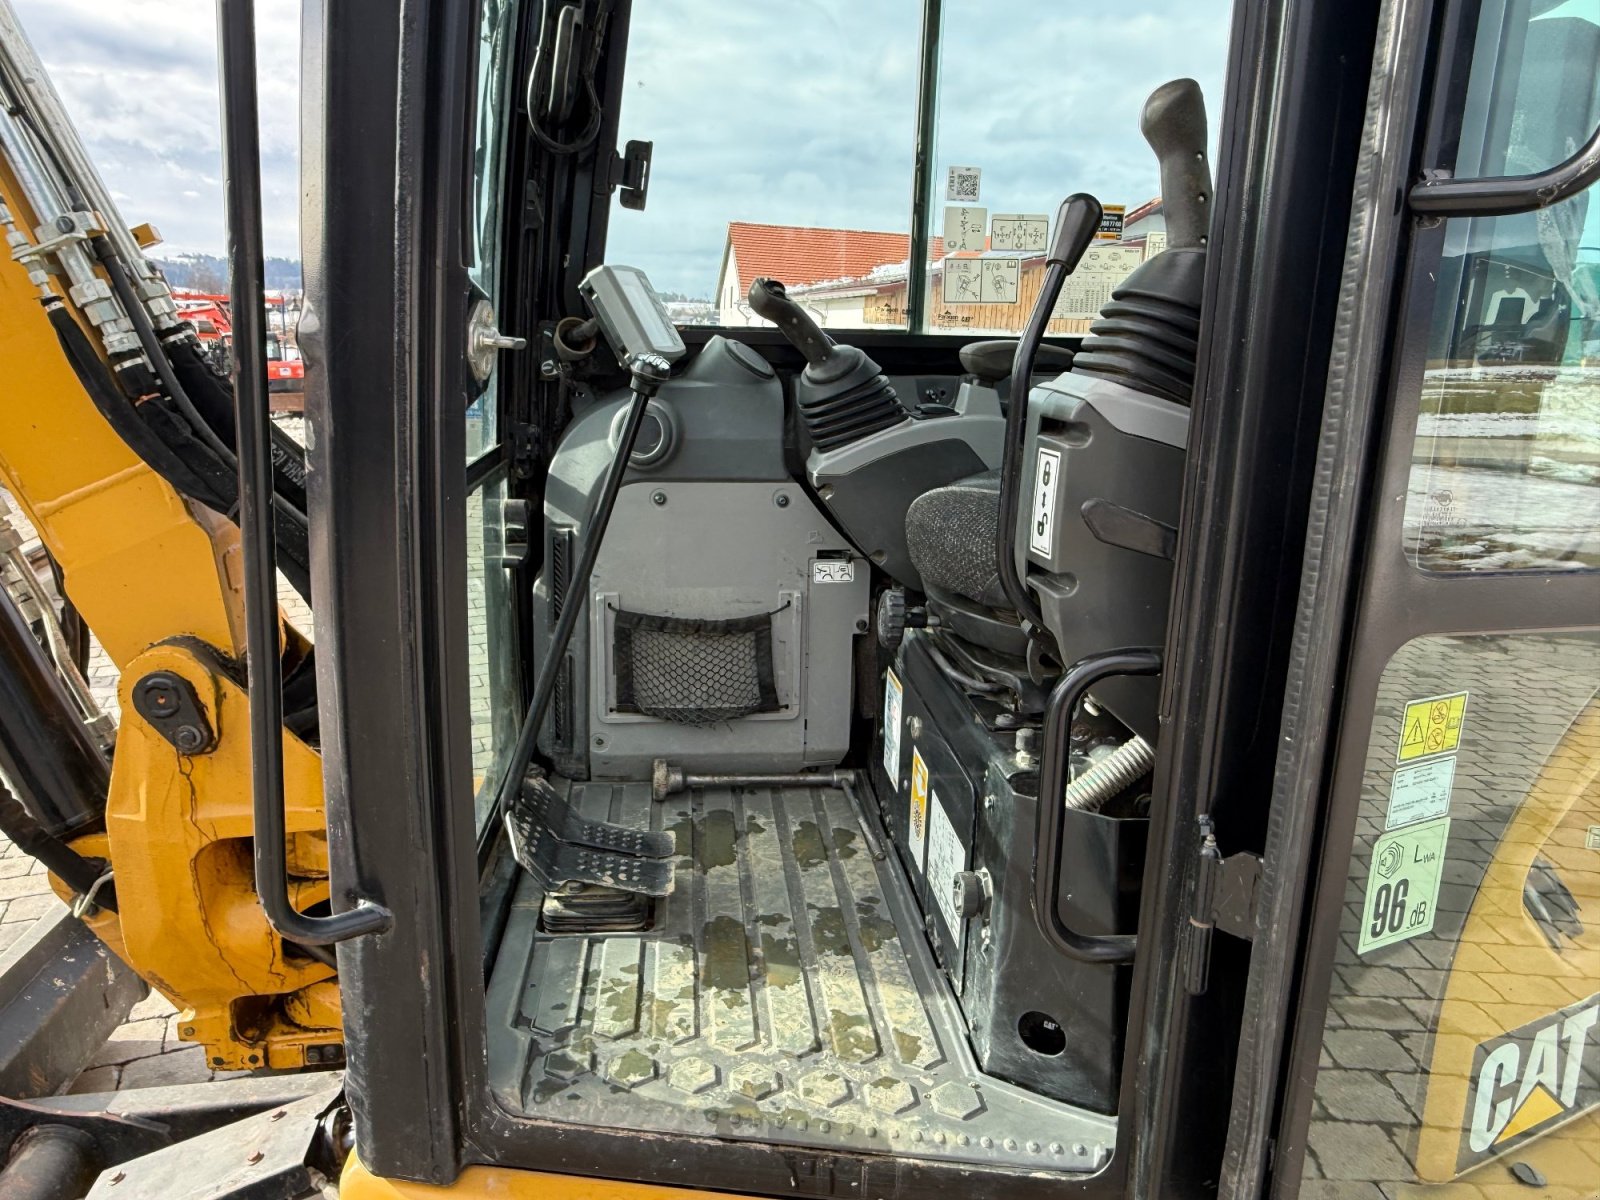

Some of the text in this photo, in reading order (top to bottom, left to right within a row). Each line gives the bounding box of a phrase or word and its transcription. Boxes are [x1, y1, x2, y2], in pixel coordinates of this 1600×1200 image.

[1370, 878, 1427, 939] 96 dB
[1469, 1004, 1600, 1153] CAT
